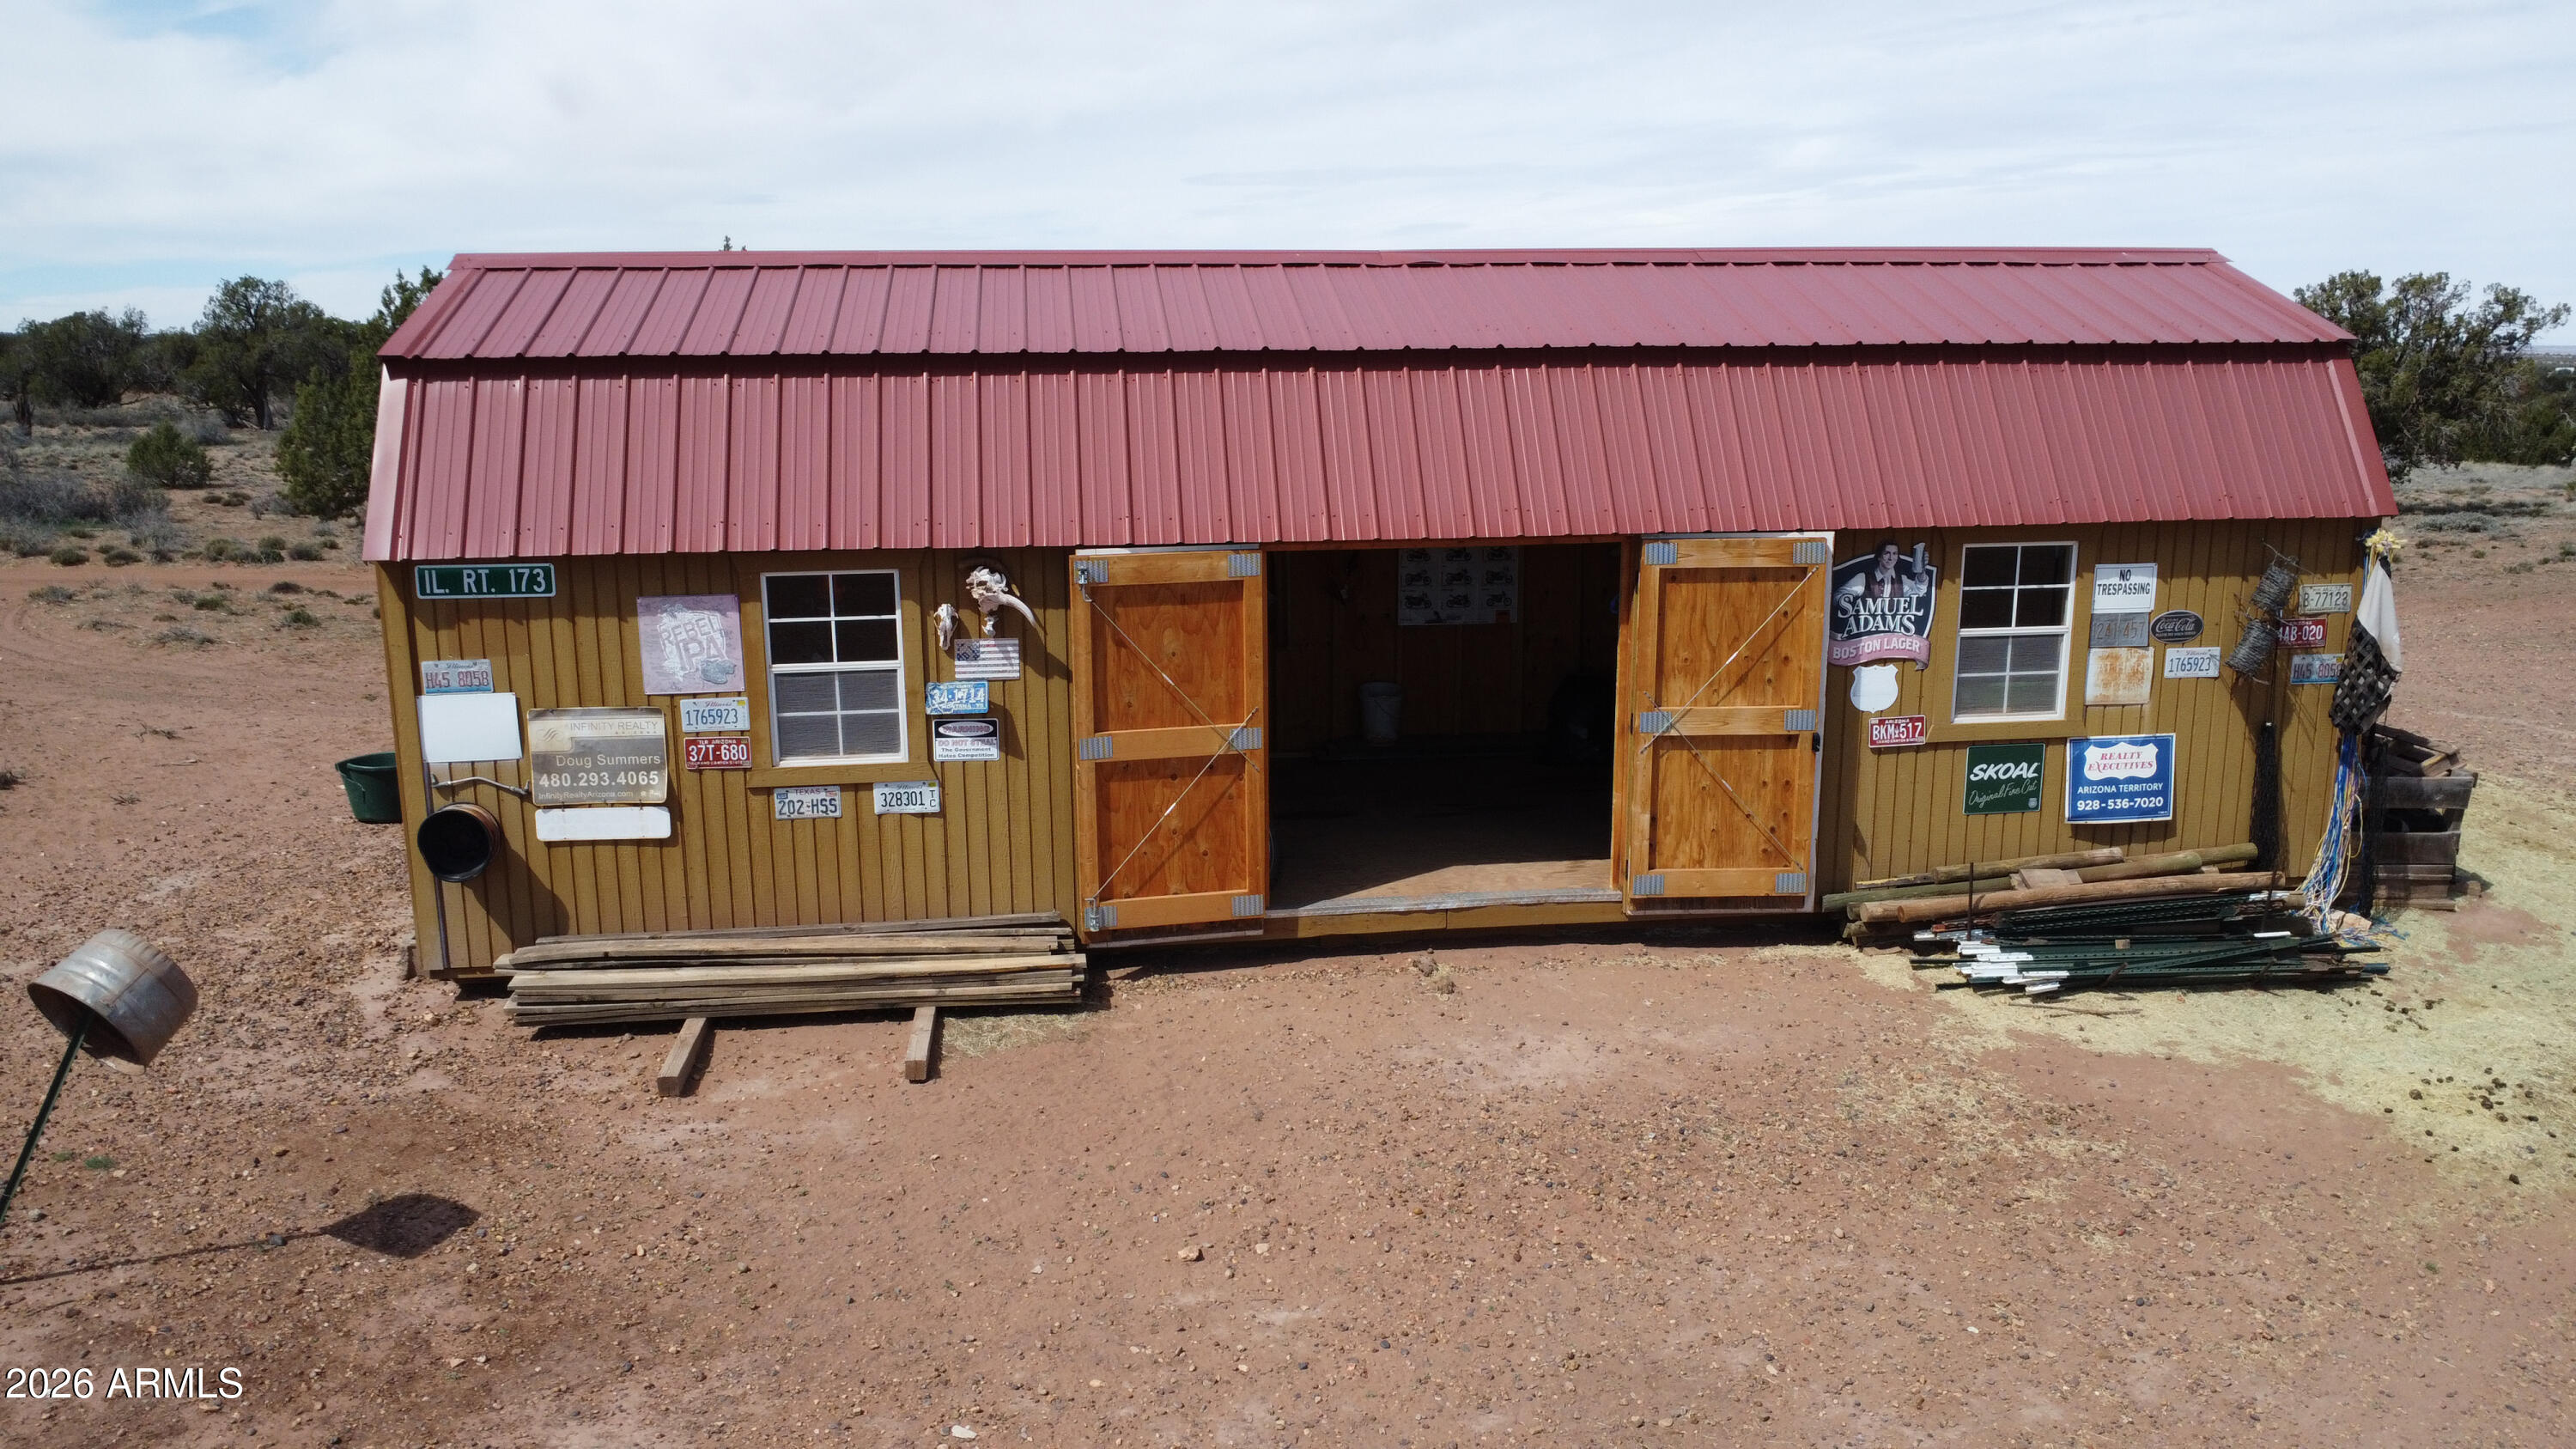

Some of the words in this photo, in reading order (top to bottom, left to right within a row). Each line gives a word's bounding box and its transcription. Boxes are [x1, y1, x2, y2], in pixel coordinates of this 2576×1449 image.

[424, 569, 450, 594] IL.
[462, 569, 495, 593] RT.
[508, 568, 546, 592] 173
[2119, 569, 2131, 582] NO
[2097, 582, 2151, 596] TRESPASSING
[1838, 594, 1924, 618] SAMUEL
[1841, 613, 1916, 638] ADAMS
[1833, 638, 1881, 660] BOSTON
[1884, 636, 1921, 653] LAGER
[2169, 658, 2211, 673] 1765923
[685, 708, 738, 726] 1765923
[570, 721, 613, 731] INFINITY
[617, 721, 659, 730] REALTY
[556, 755, 592, 768] Doug
[597, 754, 661, 766] Summers
[689, 744, 748, 762] 37T-680
[2100, 751, 2143, 760] REALTY
[1970, 761, 2038, 781] SKOAL
[2087, 760, 2154, 773] EXECUTIVES
[539, 771, 659, 788] 480.293.4065
[538, 789, 634, 801] InfinityRealtyArizona.com
[1969, 784, 2005, 808] Original
[2020, 779, 2038, 795] Cut
[2077, 785, 2117, 795] ARIZONA
[2118, 782, 2164, 793] TERRITORY
[880, 791, 926, 808] 328301
[2077, 797, 2164, 811] 928-536-7020
